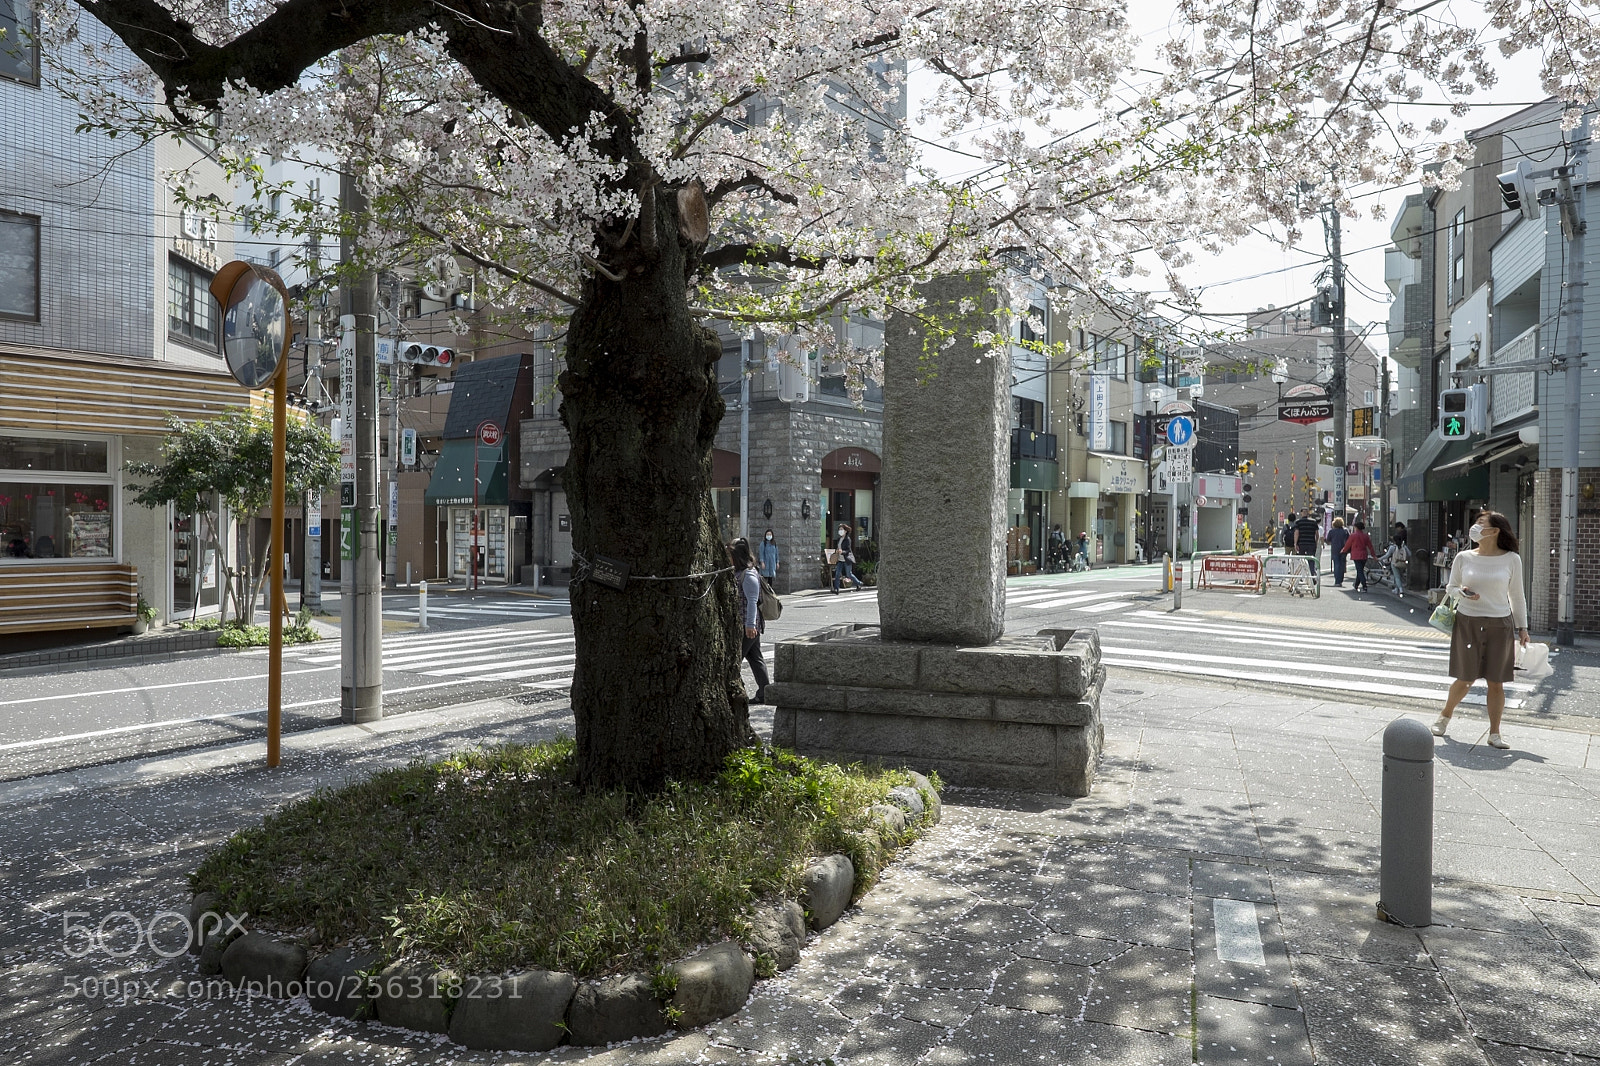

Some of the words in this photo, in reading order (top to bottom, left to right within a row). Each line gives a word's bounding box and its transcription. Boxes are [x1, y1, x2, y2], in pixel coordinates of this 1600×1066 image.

[1096, 385, 1104, 439] 上田クリニック
[1283, 407, 1330, 417] くほんぶつ
[1111, 475, 1137, 486] 上田クリニック
